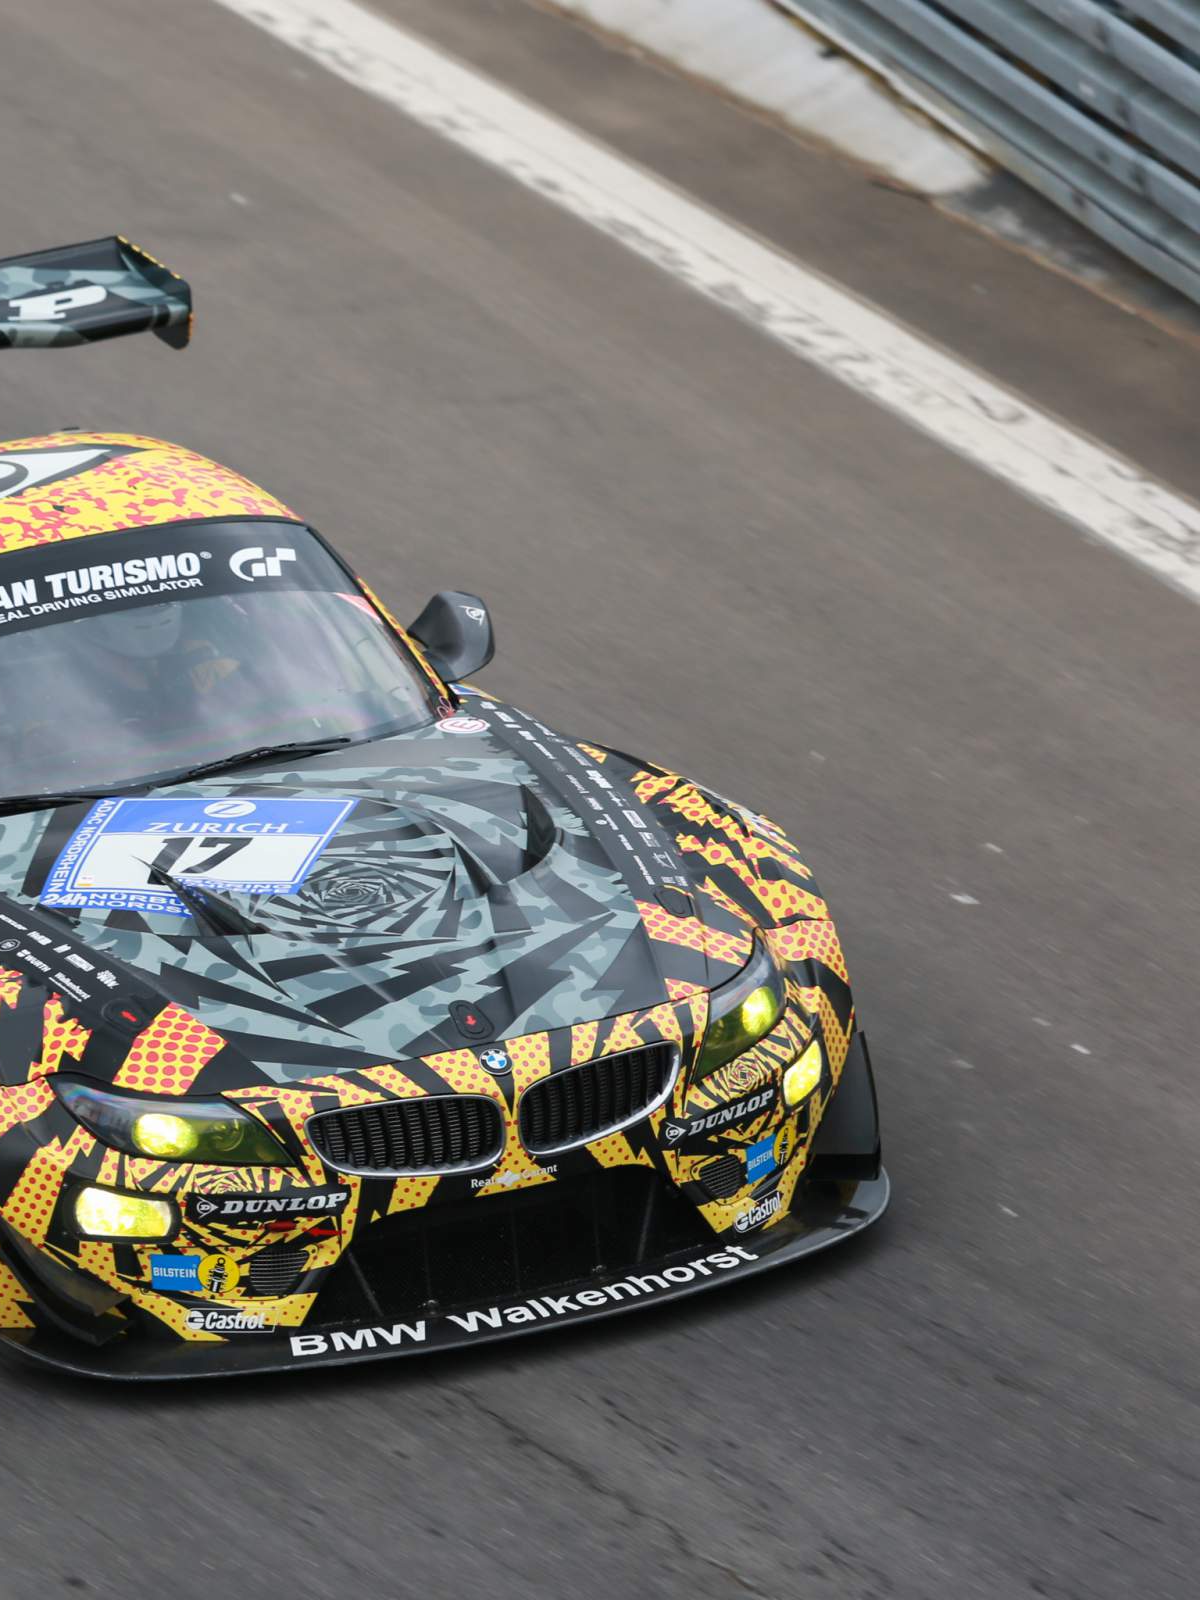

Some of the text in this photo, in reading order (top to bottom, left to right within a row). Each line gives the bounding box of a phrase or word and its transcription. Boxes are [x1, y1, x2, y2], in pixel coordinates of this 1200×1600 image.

[29, 593, 102, 616] DRIVING
[103, 578, 204, 600] SIMULATOR
[143, 822, 289, 833] ZURICH
[48, 799, 117, 893] ADAC NORDRHEIN
[147, 837, 254, 885] 17
[40, 893, 87, 906] 24h
[688, 1089, 774, 1136] DUNLOP
[747, 1150, 774, 1171] BILSTEIN
[470, 1177, 495, 1189] Real
[220, 1192, 348, 1214] DUNLOP
[748, 1191, 782, 1225] Castrol
[152, 1267, 197, 1279] BILSTEIN
[289, 1244, 760, 1357] BMW Walkenhorst
[204, 1311, 266, 1330] Castrol
